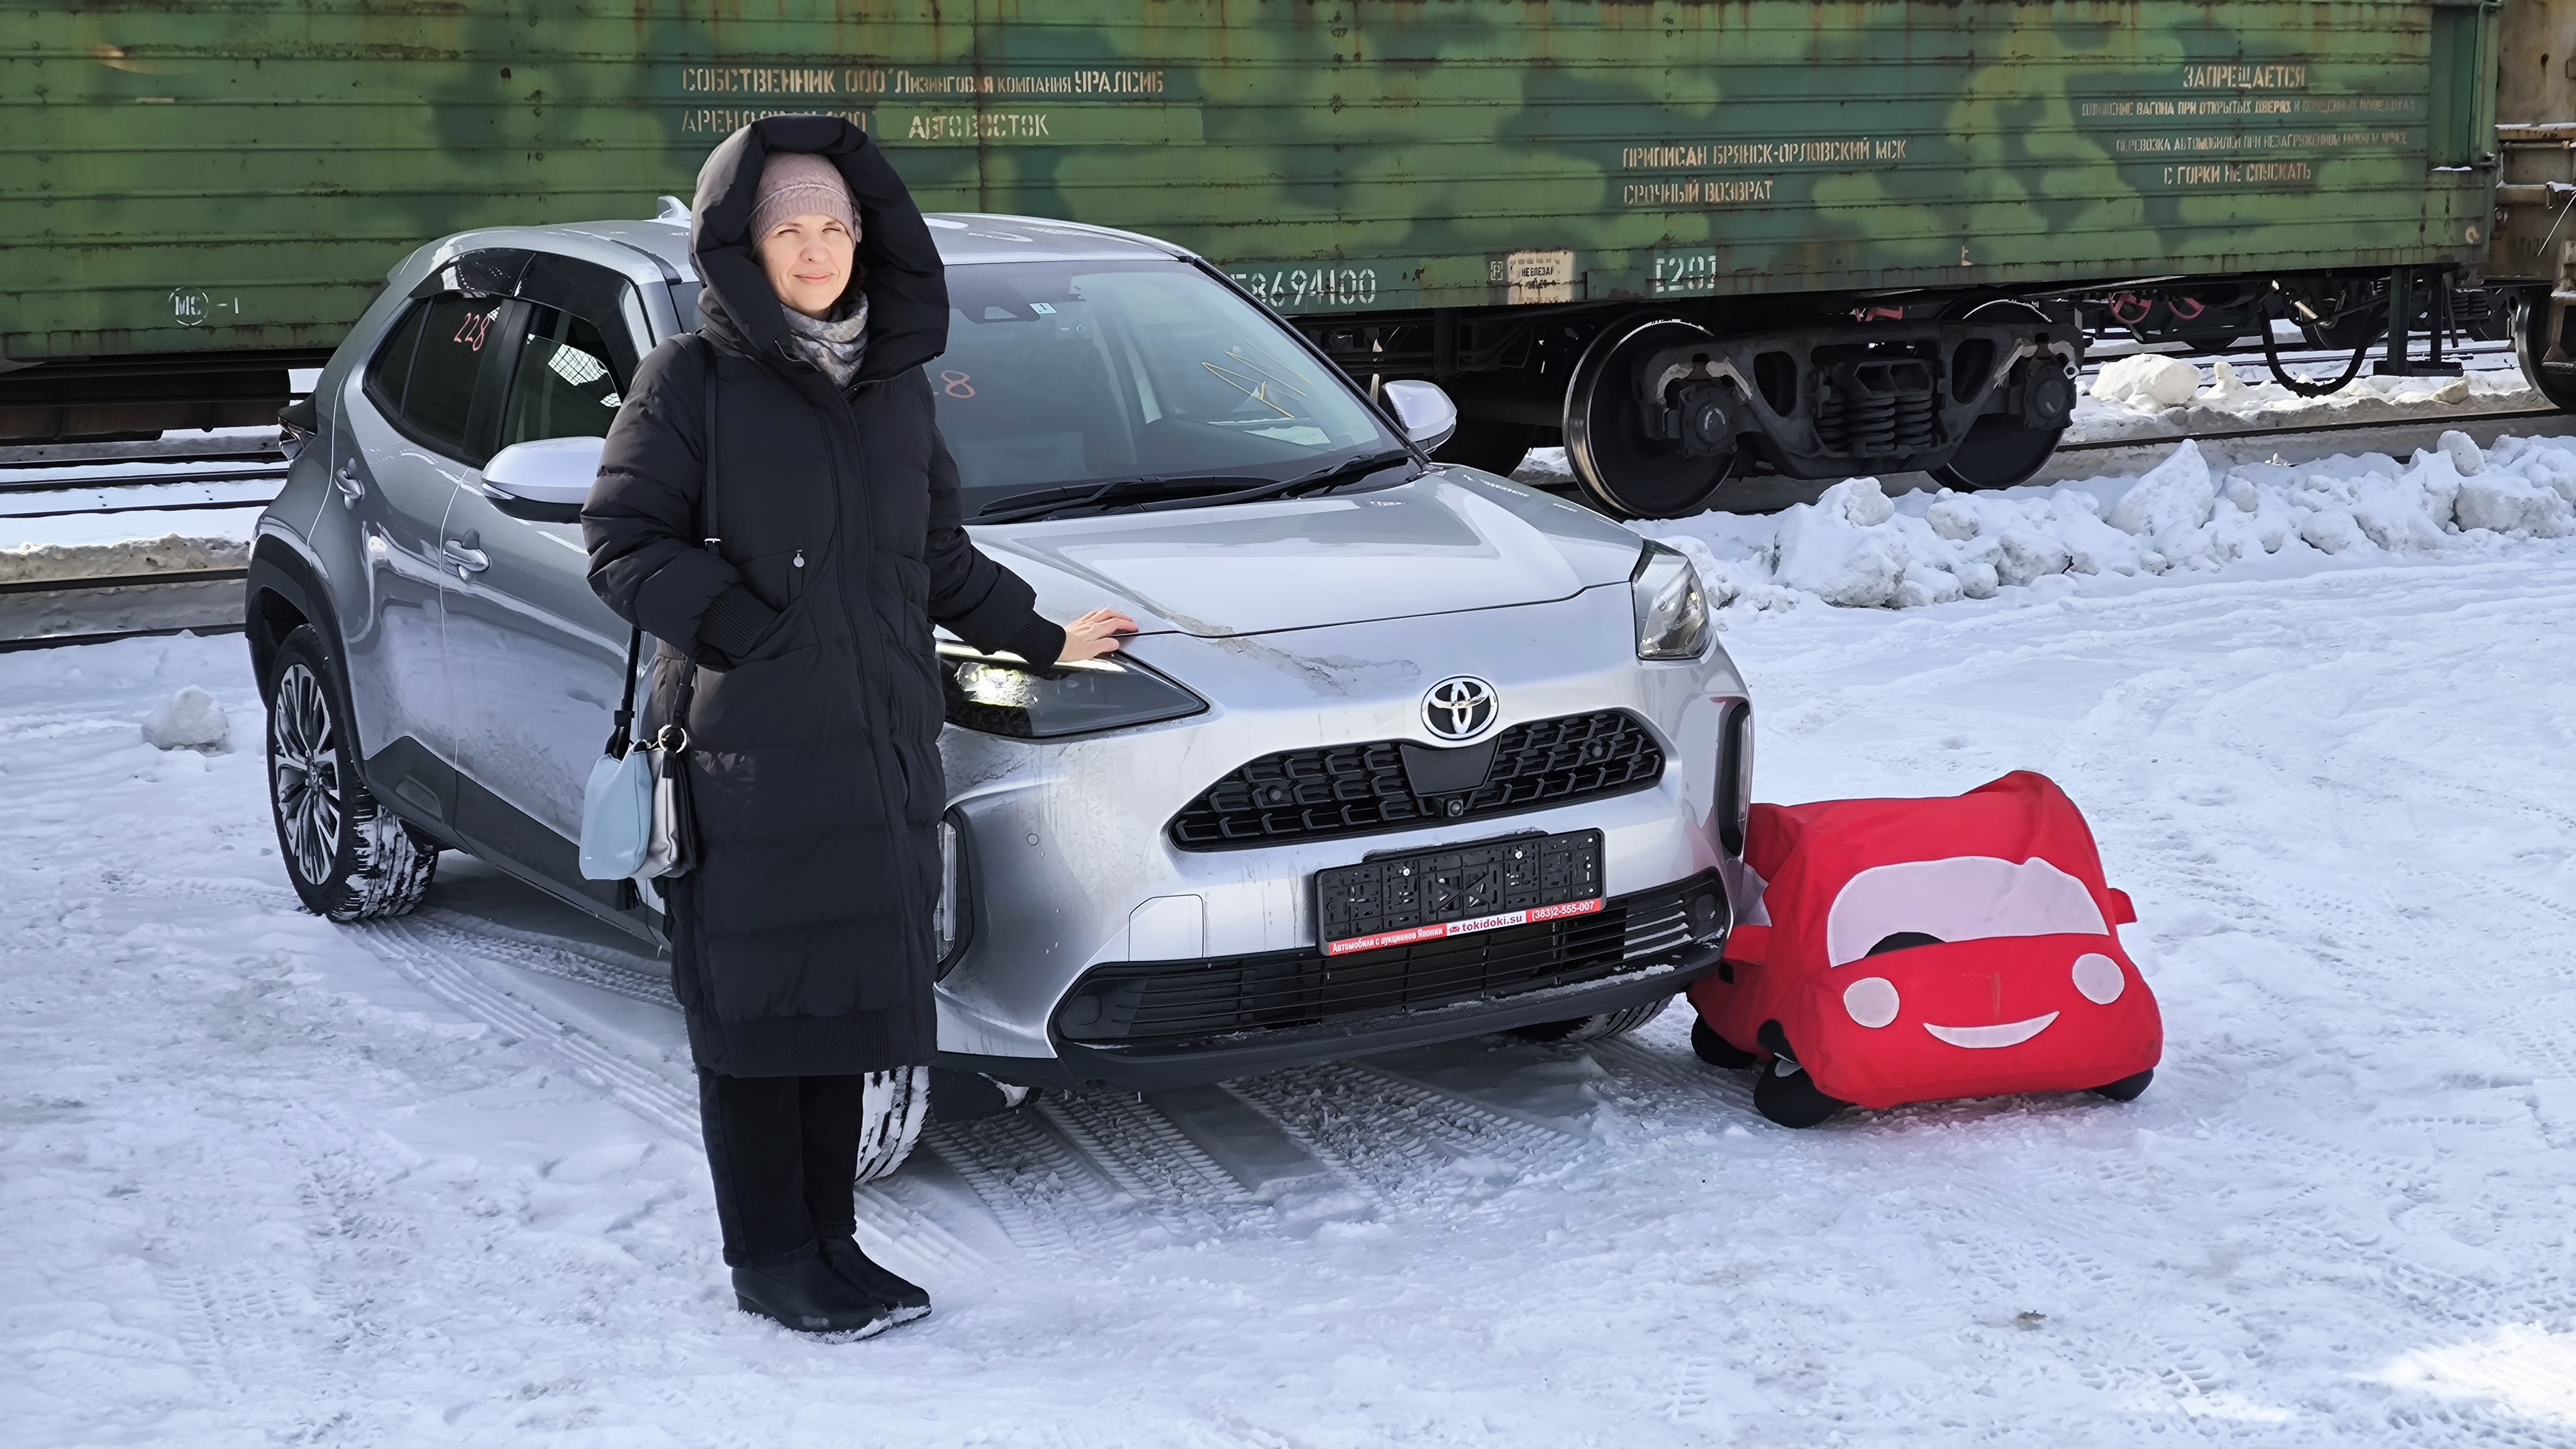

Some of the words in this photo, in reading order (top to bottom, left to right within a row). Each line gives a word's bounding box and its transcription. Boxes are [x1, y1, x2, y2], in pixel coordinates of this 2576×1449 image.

[682, 68, 836, 93] СОБСТВЕННИК
[845, 69, 886, 93] ООО
[1074, 70, 1163, 94] УРАЛСИБ
[2183, 65, 2306, 89] ЗАПРЕЩАЕТСЯ
[2136, 101, 2174, 116] ВАГОНА
[2177, 101, 2197, 115] ПРИ
[2199, 100, 2251, 115] ОТКРЫТЫХ
[1623, 146, 1707, 168] ПРИПИСАН
[1713, 137, 1870, 165] БРЯНСК-ОРЛОВСКИЙ
[1875, 140, 1907, 160] МСК
[2177, 164, 2220, 185] ГОРКИ
[2245, 162, 2311, 182] СПУСКАТЬ
[1624, 179, 1699, 204] СРОЧНЫЙ
[1704, 179, 1774, 203] ВОЗВРАТ
[1231, 269, 1376, 307] 8694100
[453, 312, 490, 352] 228
[933, 370, 976, 399] 8
[1462, 915, 1523, 932] tokidoki.su
[1531, 901, 1595, 923] (383)2-555-007
[1332, 938, 1374, 953] Автомобили
[1380, 932, 1417, 947] аукционов
[1417, 927, 1443, 939] Японии
